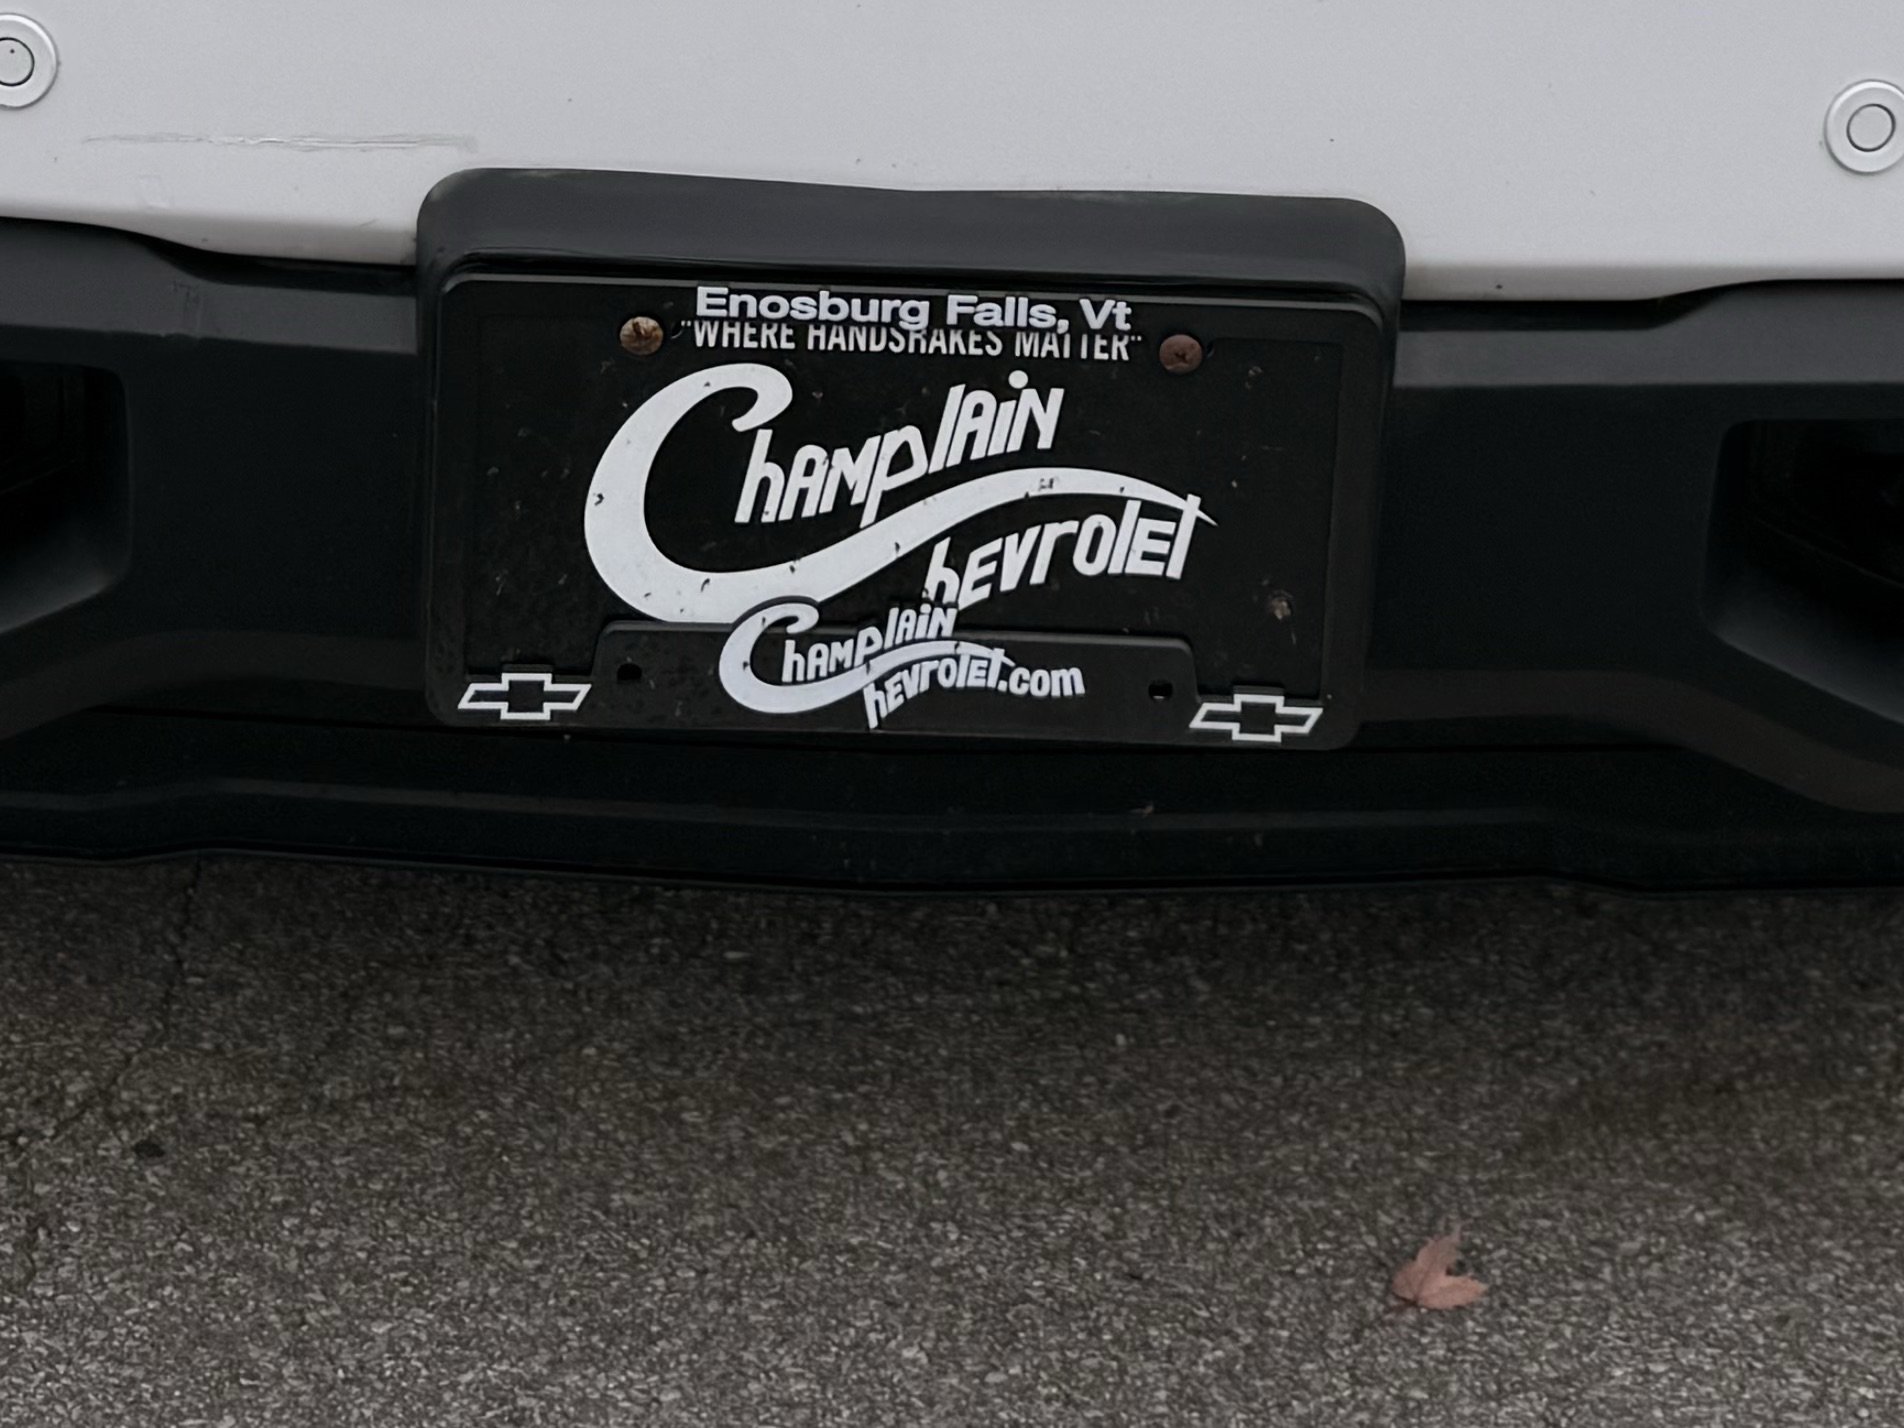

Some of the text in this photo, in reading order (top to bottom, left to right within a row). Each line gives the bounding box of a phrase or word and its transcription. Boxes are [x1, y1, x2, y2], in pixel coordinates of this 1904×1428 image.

[695, 286, 1132, 334] Enosburg Falls, Vt
